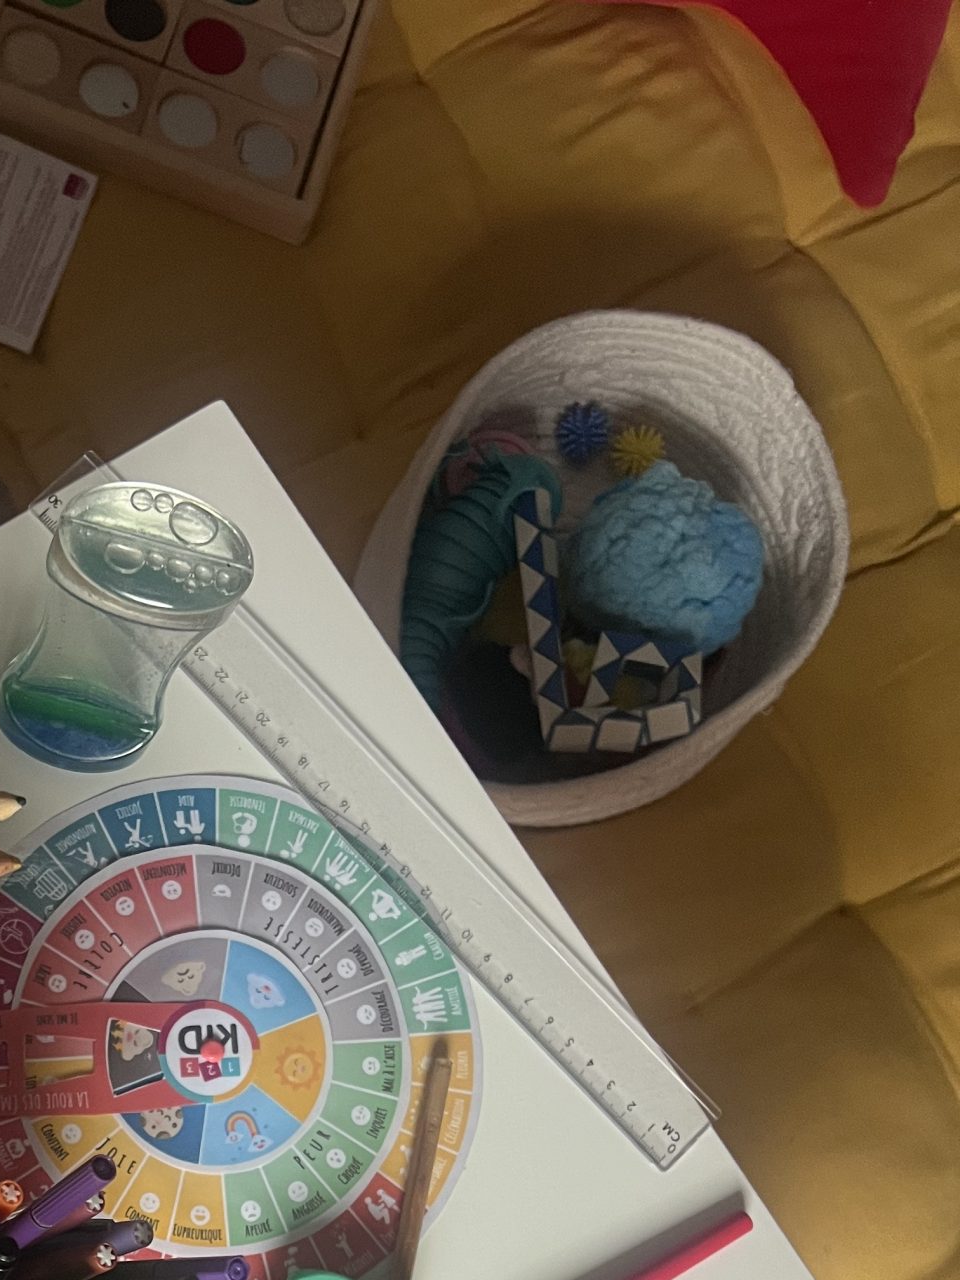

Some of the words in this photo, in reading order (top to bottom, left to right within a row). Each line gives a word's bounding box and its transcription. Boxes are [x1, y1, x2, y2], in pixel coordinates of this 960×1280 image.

[48, 494, 62, 509] 30
[194, 646, 208, 661] 23
[215, 668, 229, 683] 22
[235, 691, 248, 704] 21
[256, 712, 270, 727] 20
[277, 736, 289, 748] 19
[298, 756, 310, 770] 18
[318, 780, 330, 792] 17
[178, 795, 195, 808] AIDE
[229, 796, 266, 814] TENDRESSE
[339, 800, 351, 813] 16
[115, 801, 143, 820] JUSTICE
[288, 810, 320, 834] PARTAGER
[361, 822, 371, 835] 15
[380, 843, 392, 856] 14
[400, 865, 412, 878] 13
[264, 873, 299, 898] SOUCIEUX
[420, 885, 433, 900] 12
[307, 898, 345, 937] MALHEUREUX
[441, 908, 452, 921] 11
[461, 929, 474, 943] 10
[264, 916, 339, 995] TRISTESSE
[347, 944, 375, 977] DÉPRIMÉ
[483, 953, 492, 963] 9
[504, 973, 514, 984] 8
[444, 985, 463, 1016] AMITIÉ
[524, 997, 534, 1006] 7
[544, 1016, 555, 1025] 6
[564, 1037, 575, 1048] 5
[585, 1059, 595, 1068] 4
[606, 1080, 616, 1090] 3
[23, 1094, 41, 1111] DES
[46, 1092, 73, 1109] ROUE
[76, 1091, 89, 1109] LA
[626, 1101, 637, 1112] 2
[366, 1107, 388, 1140] INQUIET
[647, 1122, 656, 1133] 1
[96, 1136, 137, 1175] JOIE
[293, 1130, 332, 1169] PEUR
[667, 1143, 677, 1155] 0
[337, 1156, 363, 1185] CHOQUÉ
[244, 1219, 273, 1237] APEURÉ
